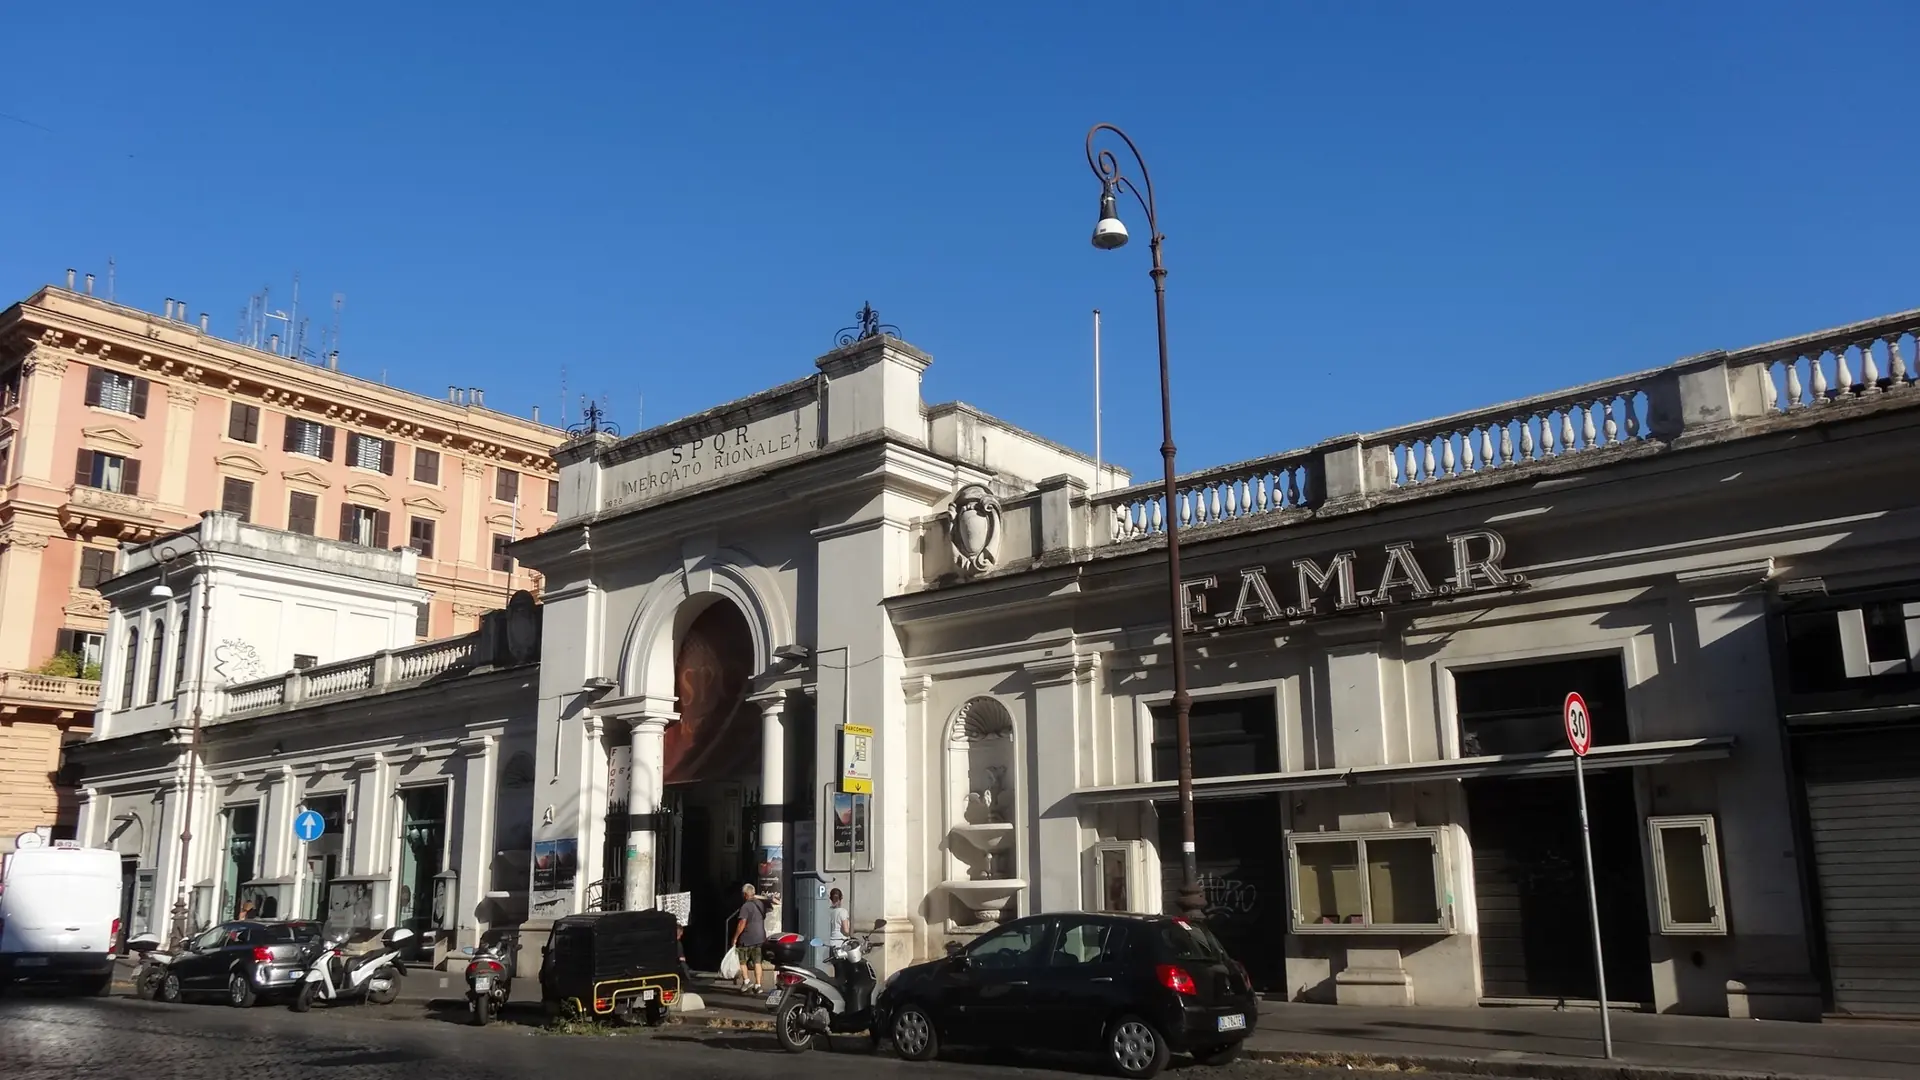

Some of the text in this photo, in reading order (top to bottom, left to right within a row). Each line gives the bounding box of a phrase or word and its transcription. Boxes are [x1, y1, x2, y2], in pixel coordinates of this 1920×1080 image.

[627, 433, 791, 494] MERCATO RIONALE
[845, 725, 872, 734] PARCOMETRO
[1571, 709, 1585, 739] 30
[819, 886, 826, 898] P
